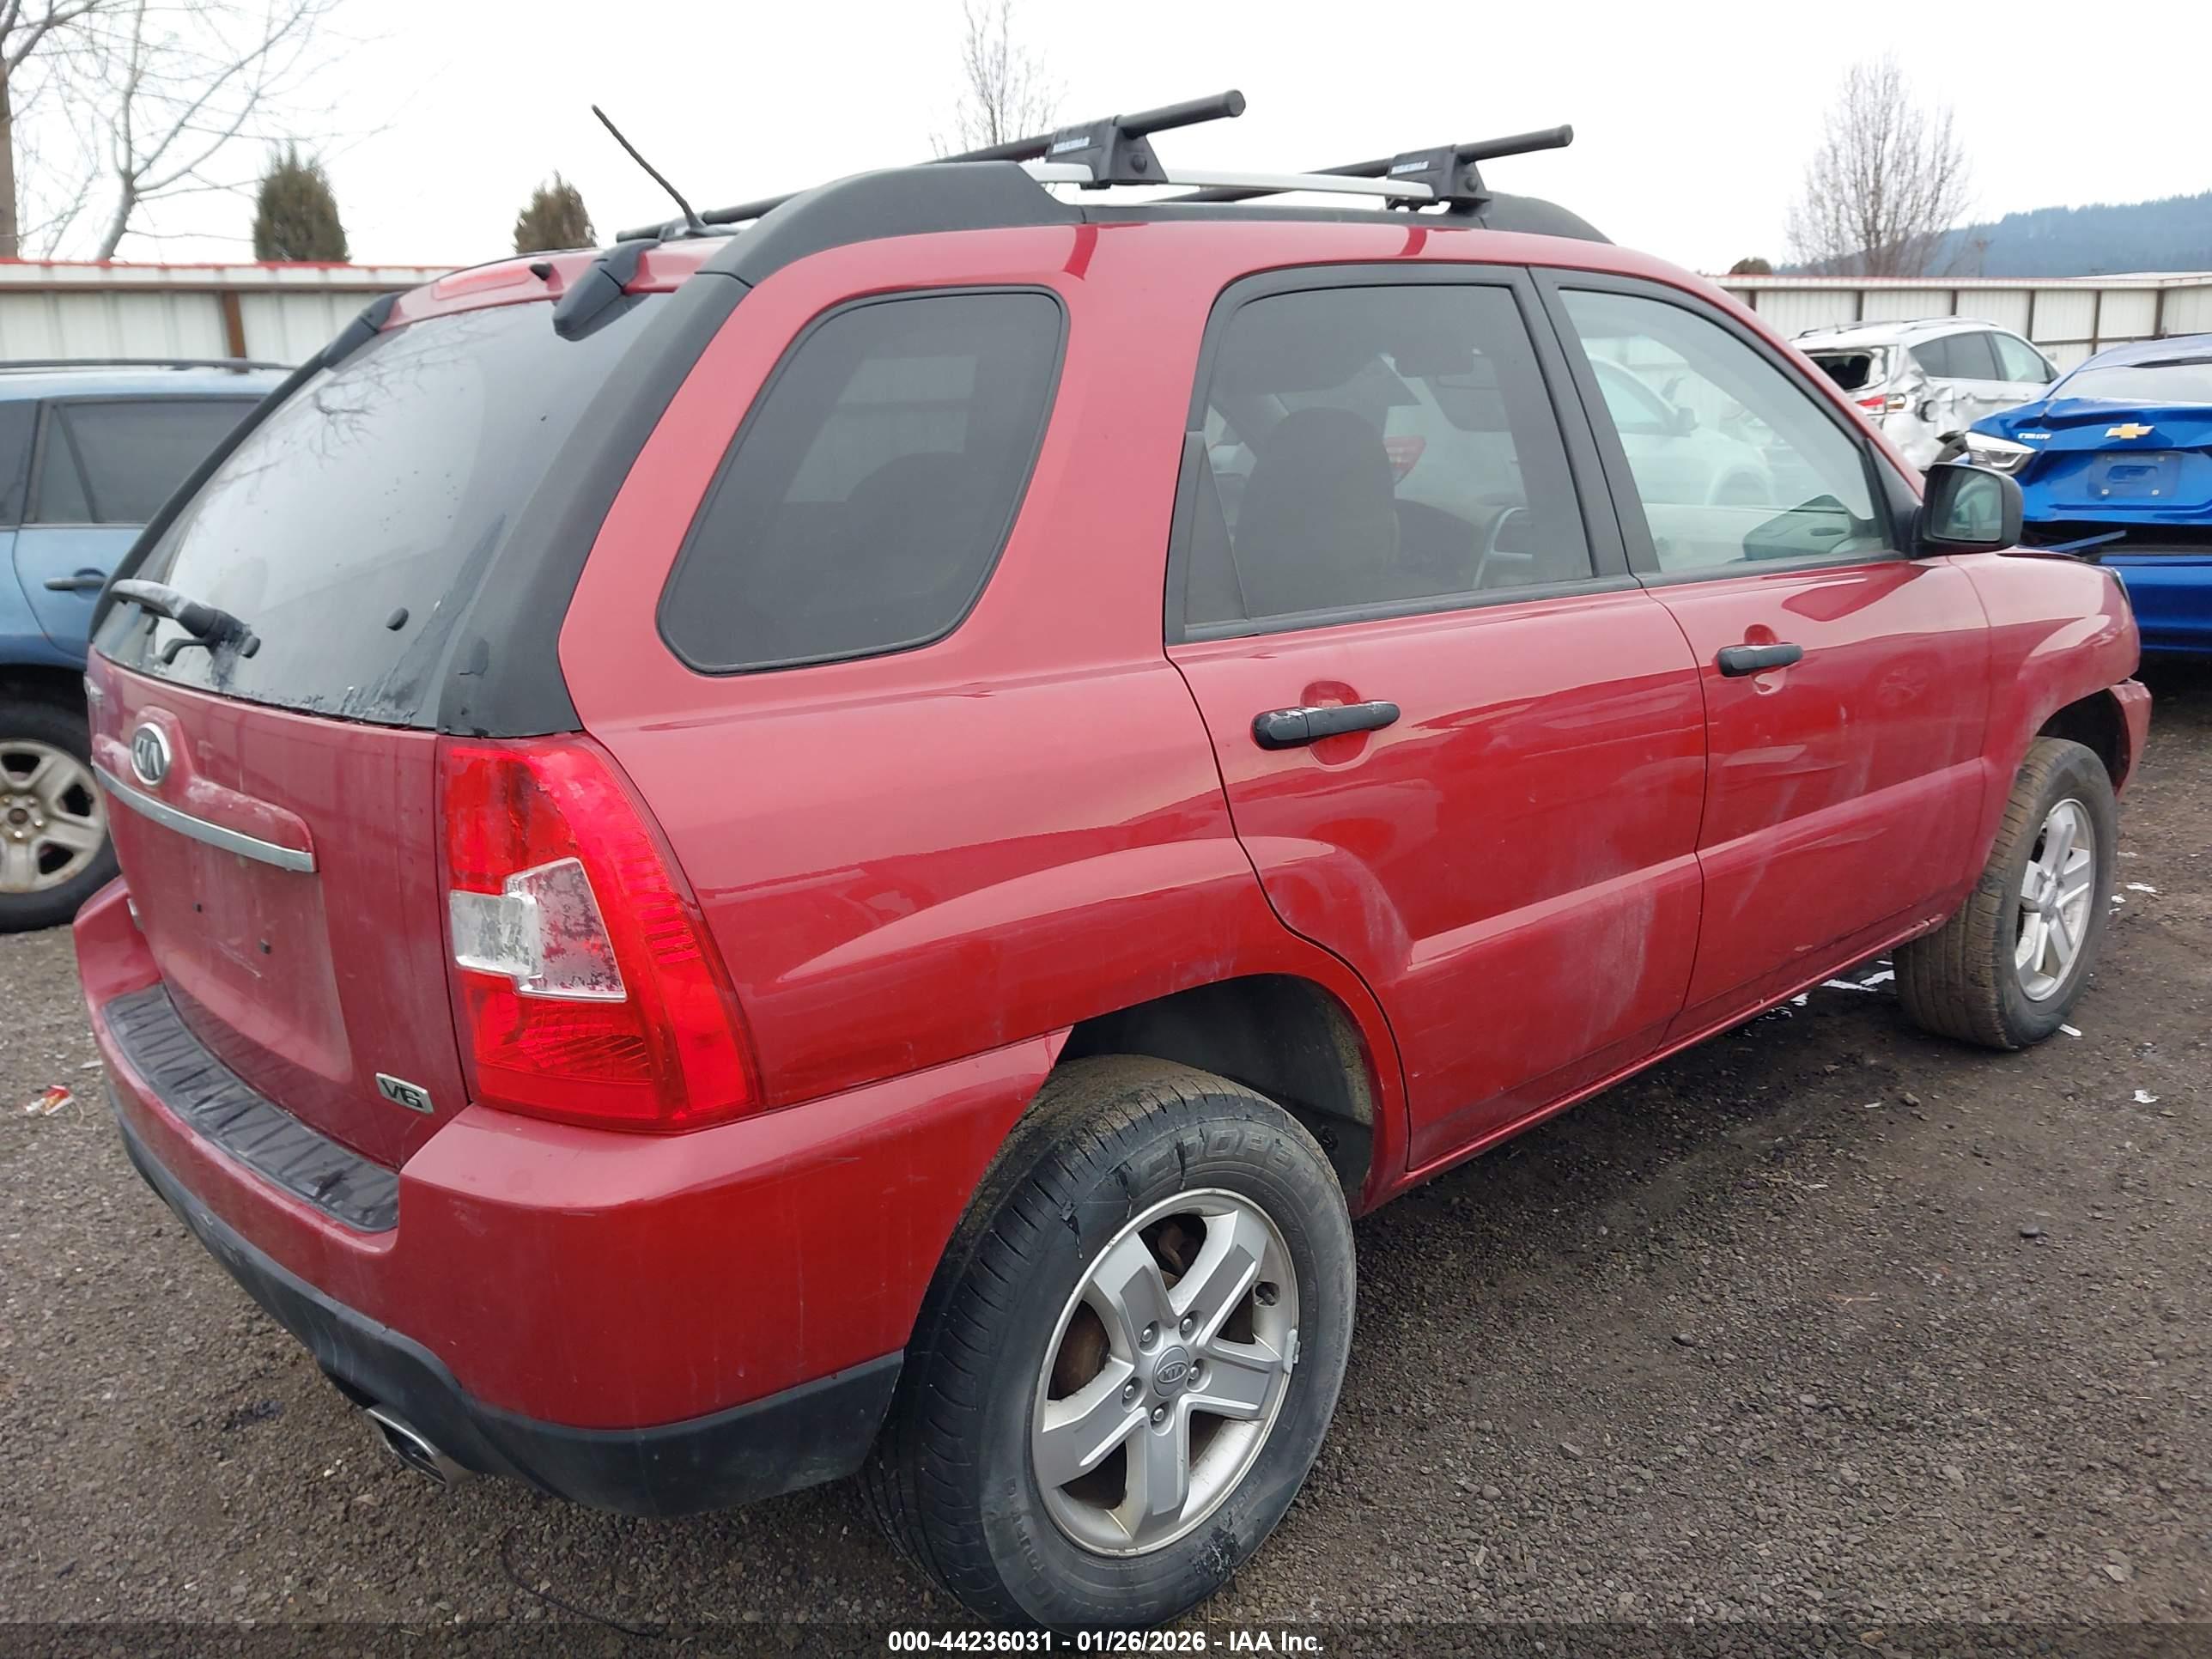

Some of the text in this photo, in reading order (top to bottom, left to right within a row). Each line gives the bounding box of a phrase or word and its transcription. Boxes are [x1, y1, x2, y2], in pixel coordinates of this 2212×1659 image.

[134, 733, 161, 777] KIA
[380, 1078, 425, 1109] V6
[1139, 1127, 1307, 1183] COOPE
[1158, 1364, 1187, 1382] KIA
